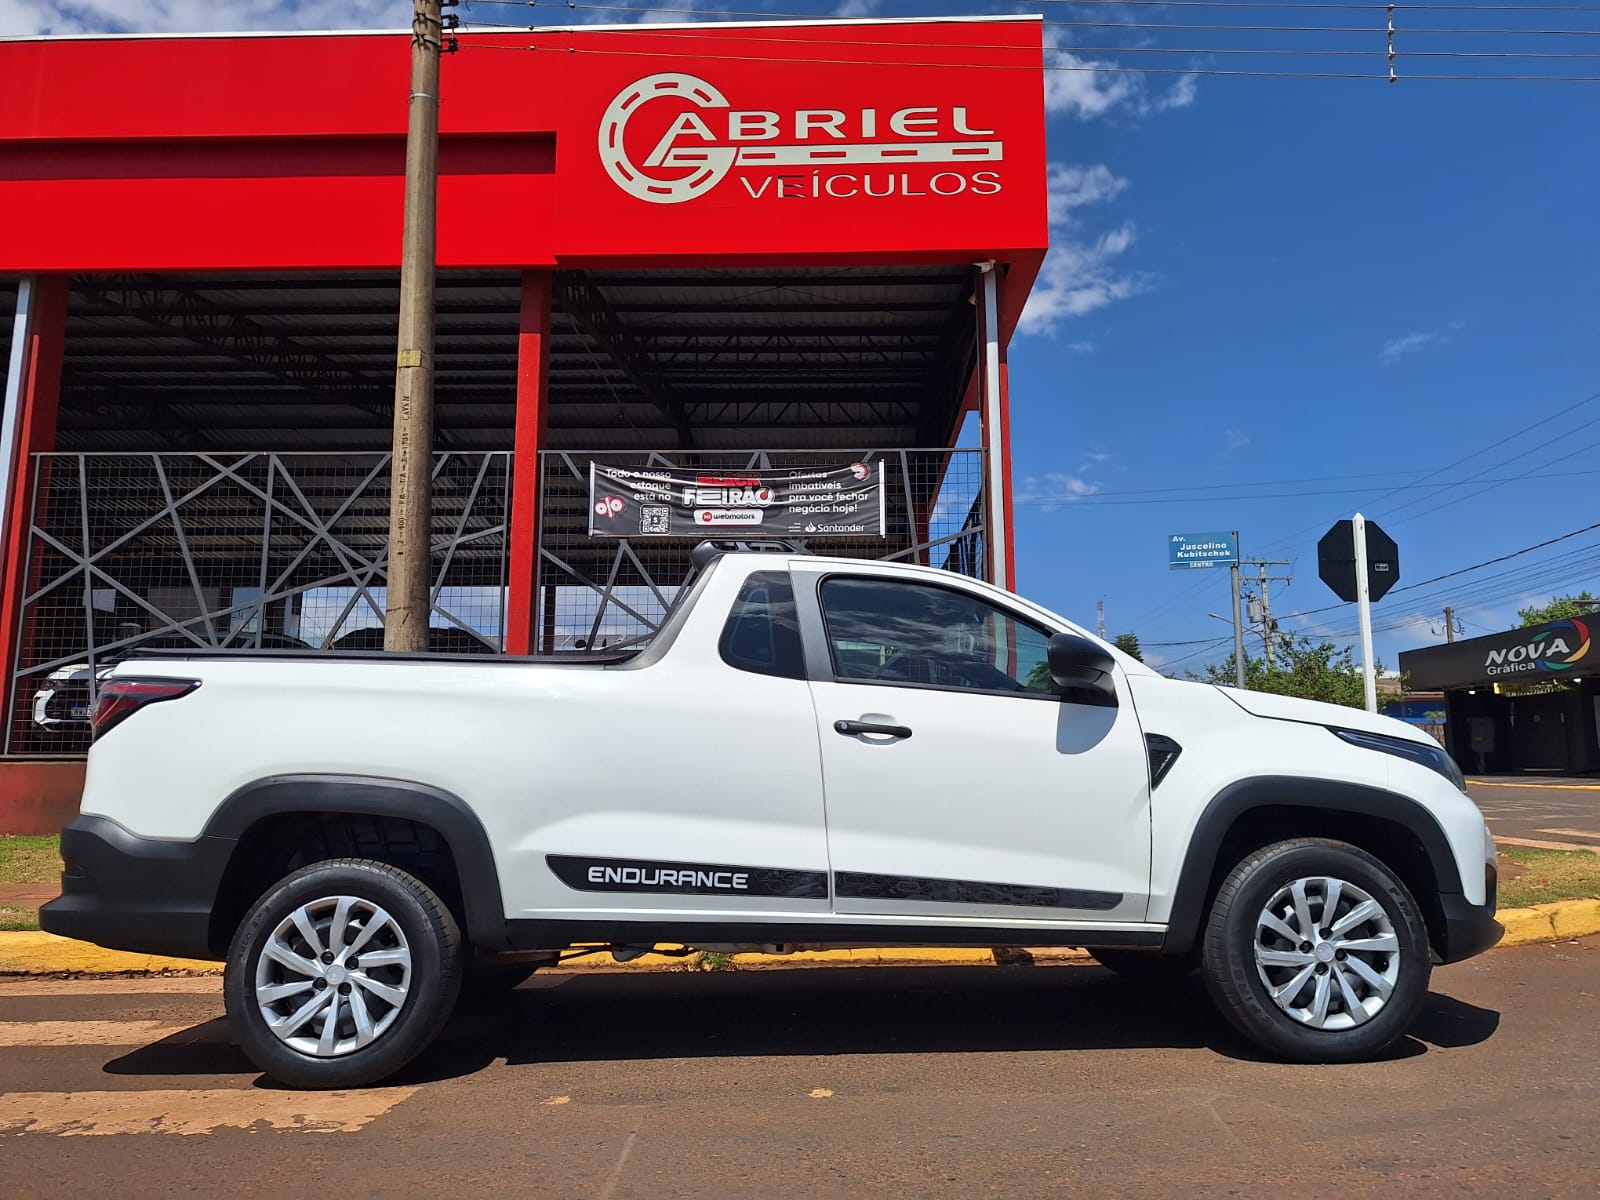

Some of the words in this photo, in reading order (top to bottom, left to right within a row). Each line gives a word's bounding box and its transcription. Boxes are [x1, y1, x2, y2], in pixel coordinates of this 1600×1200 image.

[740, 170, 1002, 199] VEÍCULOS
[606, 468, 631, 478] Todo
[630, 481, 672, 490] estoque
[633, 491, 656, 500] está
[789, 494, 806, 502] pra
[809, 492, 834, 500] você
[836, 492, 869, 500] fechar
[789, 504, 830, 515] negócio
[832, 503, 858, 515] hoje!
[817, 523, 865, 532] Santander
[1172, 535, 1186, 543] Av.
[1180, 542, 1227, 551] Juscelino
[1485, 638, 1571, 667] NOVA
[1487, 660, 1536, 676] Gráfica
[587, 865, 749, 890] ENDURANCE
